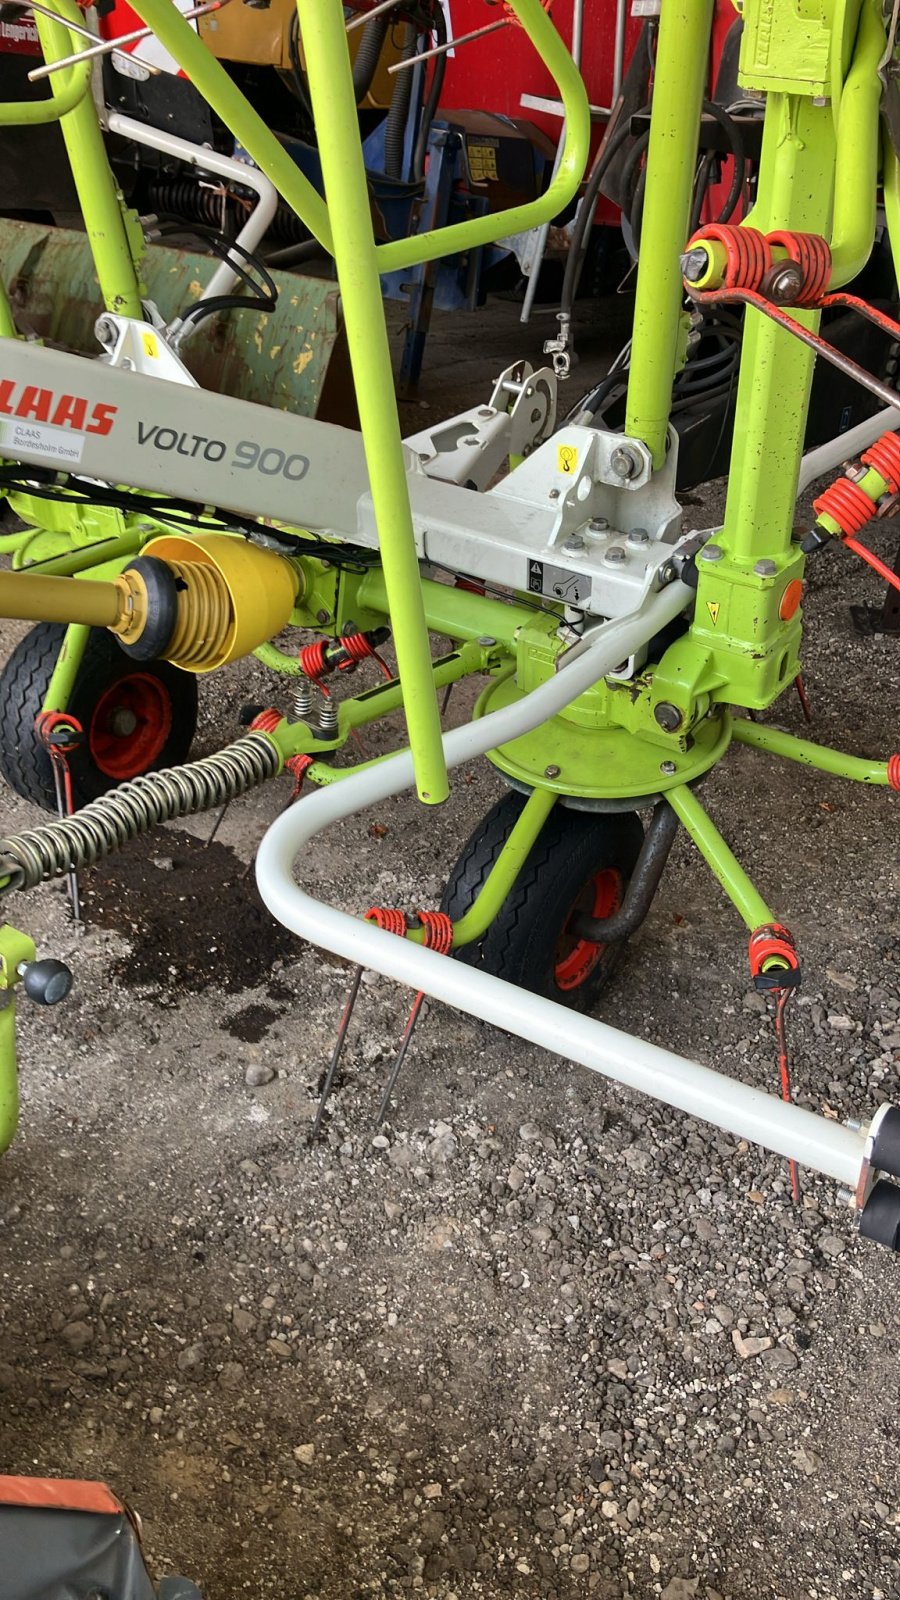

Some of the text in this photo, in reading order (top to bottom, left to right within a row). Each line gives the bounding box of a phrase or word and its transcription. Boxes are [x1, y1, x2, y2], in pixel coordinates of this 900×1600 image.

[15, 426, 41, 440] CLAAS
[13, 436, 80, 458] Bordesholm GmbH
[138, 421, 311, 481] VOLTO 900
